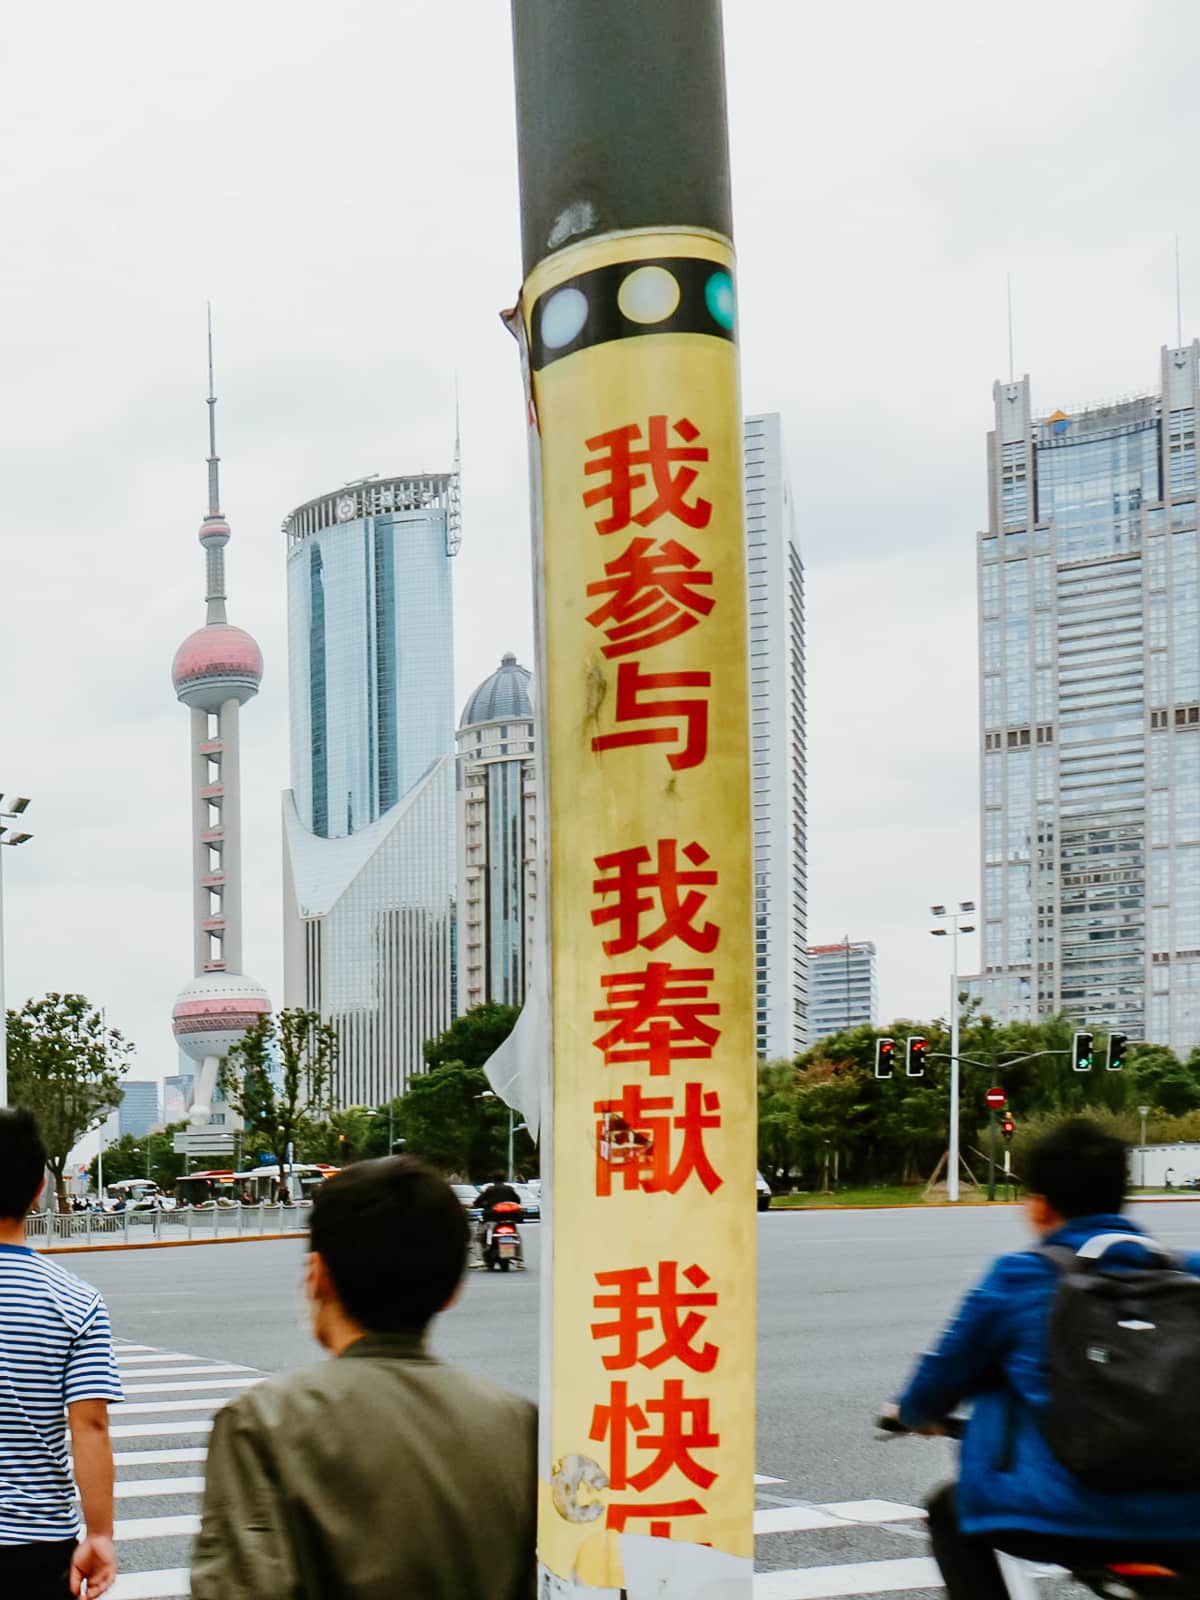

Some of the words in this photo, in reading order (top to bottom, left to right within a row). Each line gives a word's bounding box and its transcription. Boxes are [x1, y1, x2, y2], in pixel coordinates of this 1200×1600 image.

[583, 415, 715, 770] 我参与
[590, 838, 722, 1195] 我奉献
